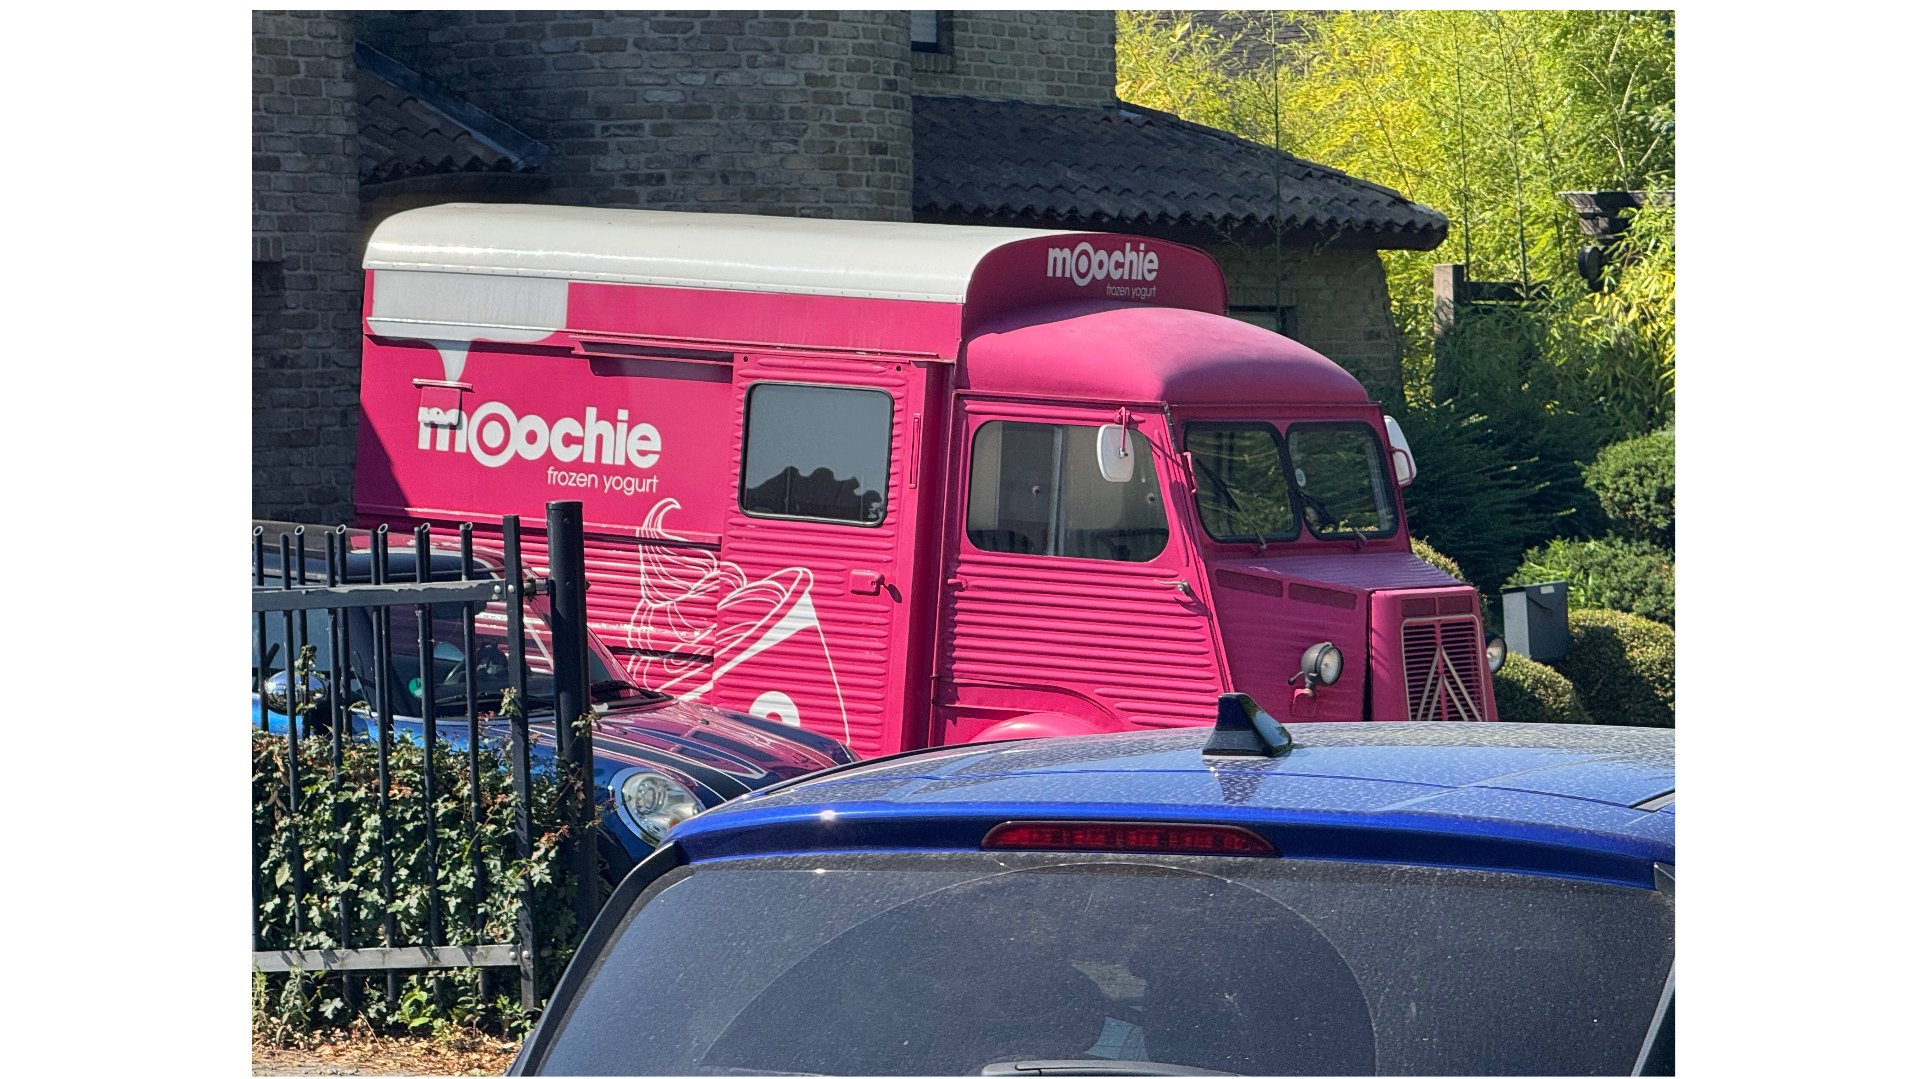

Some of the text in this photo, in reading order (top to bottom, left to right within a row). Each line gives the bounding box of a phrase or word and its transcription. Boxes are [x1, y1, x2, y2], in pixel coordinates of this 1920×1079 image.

[1106, 283, 1157, 300] frozen yogurt
[547, 466, 659, 496] frozen yogurt
